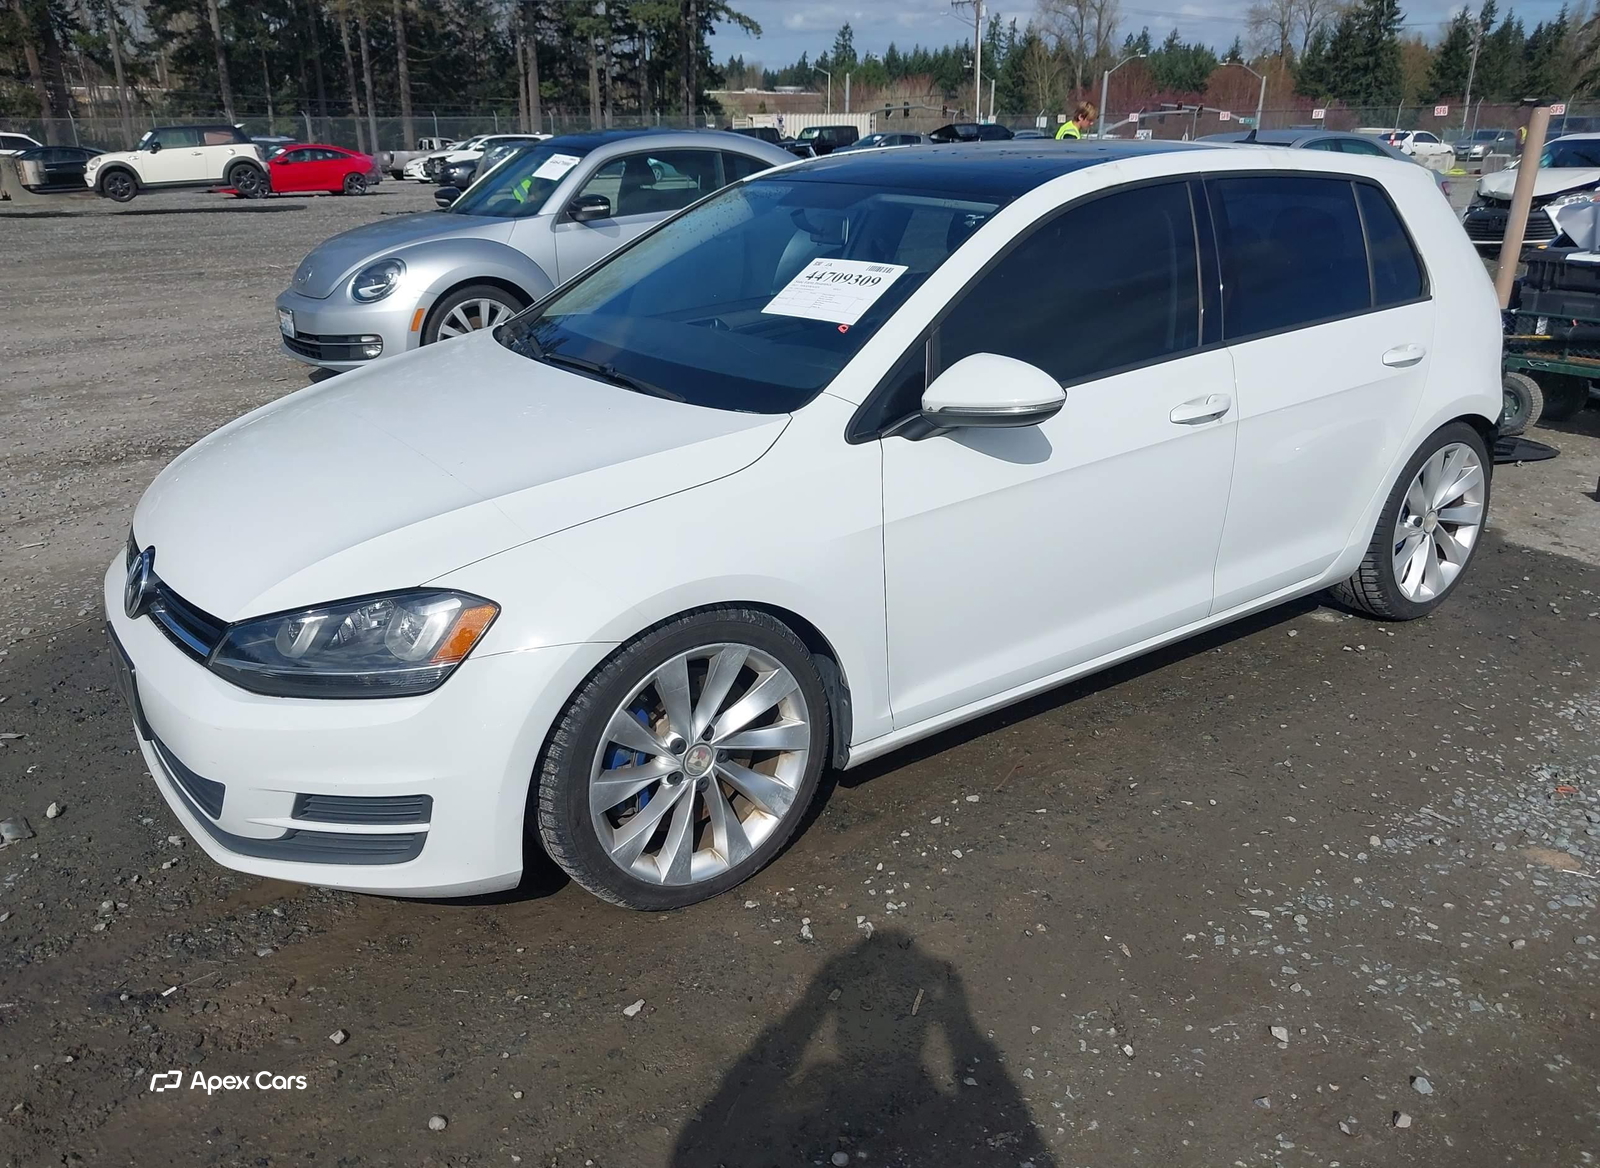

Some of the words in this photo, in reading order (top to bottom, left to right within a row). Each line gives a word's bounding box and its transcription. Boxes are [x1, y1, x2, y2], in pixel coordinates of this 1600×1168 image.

[1435, 106, 1447, 115] SF6
[1550, 105, 1564, 114] SF5
[805, 270, 882, 288] 44709309
